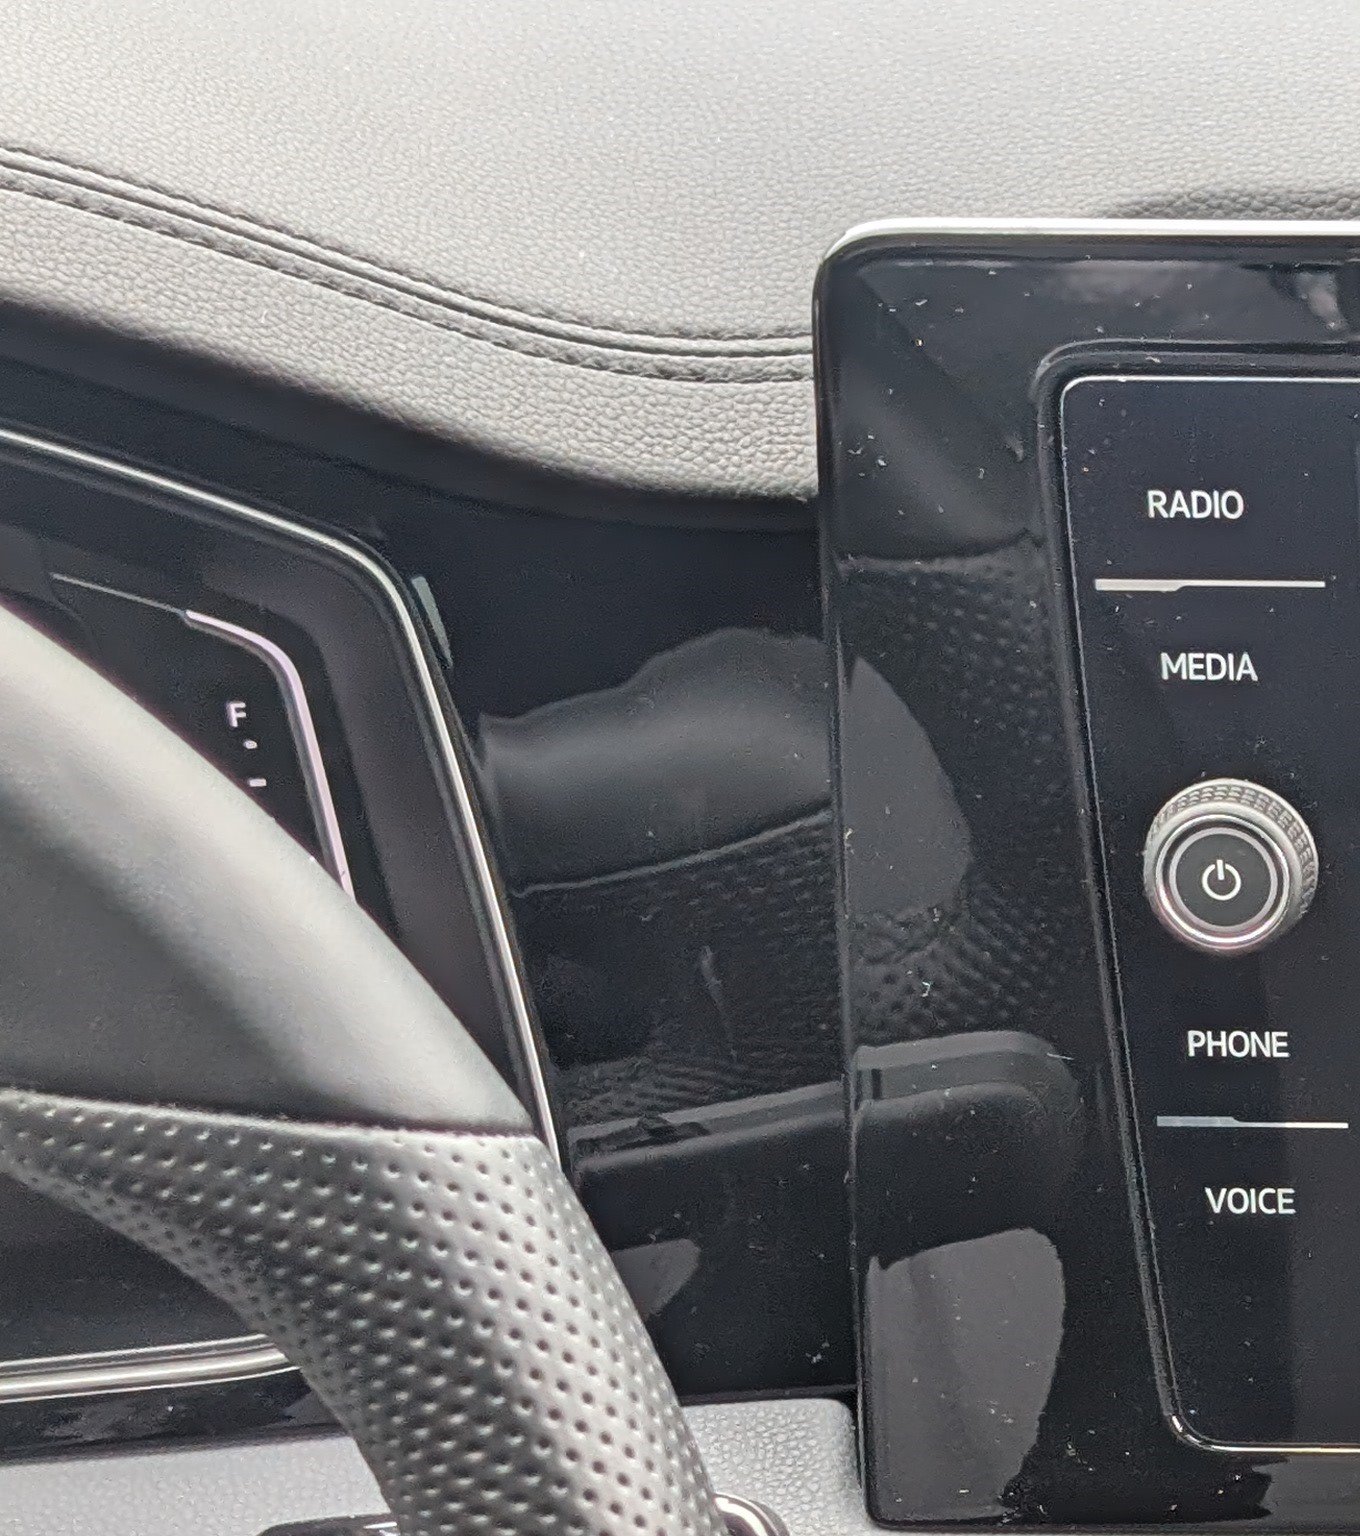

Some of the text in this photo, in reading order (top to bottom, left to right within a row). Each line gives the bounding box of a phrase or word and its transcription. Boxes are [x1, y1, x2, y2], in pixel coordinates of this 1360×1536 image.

[1147, 489, 1244, 520] RADIO
[1160, 652, 1259, 682] MEDIA
[226, 701, 247, 728] F
[1187, 1029, 1290, 1058] PHONE
[1204, 1187, 1297, 1215] VOICE
